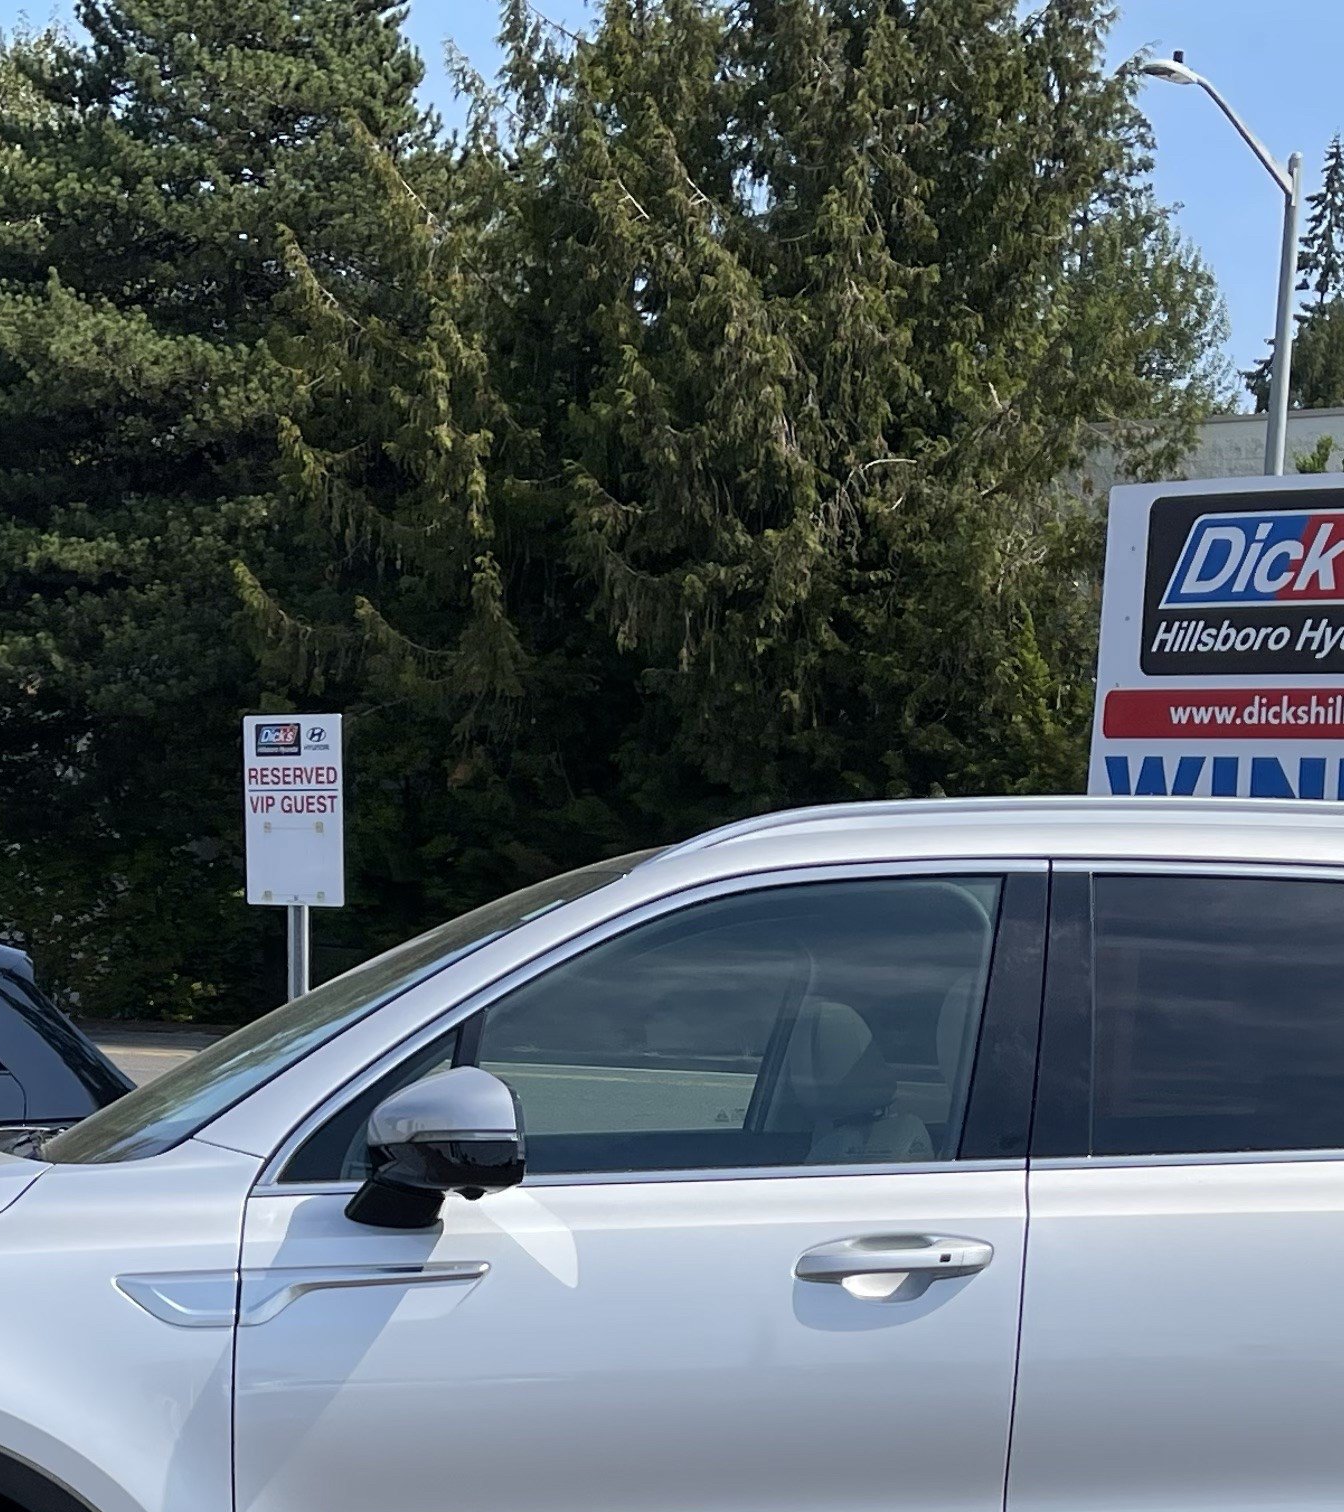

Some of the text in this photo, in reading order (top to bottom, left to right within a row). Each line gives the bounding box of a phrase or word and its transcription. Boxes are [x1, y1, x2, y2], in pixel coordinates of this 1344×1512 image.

[1151, 618, 1291, 653] Hillsboro
[248, 766, 339, 786] RESERVED
[249, 794, 339, 814] VIP GUEST
